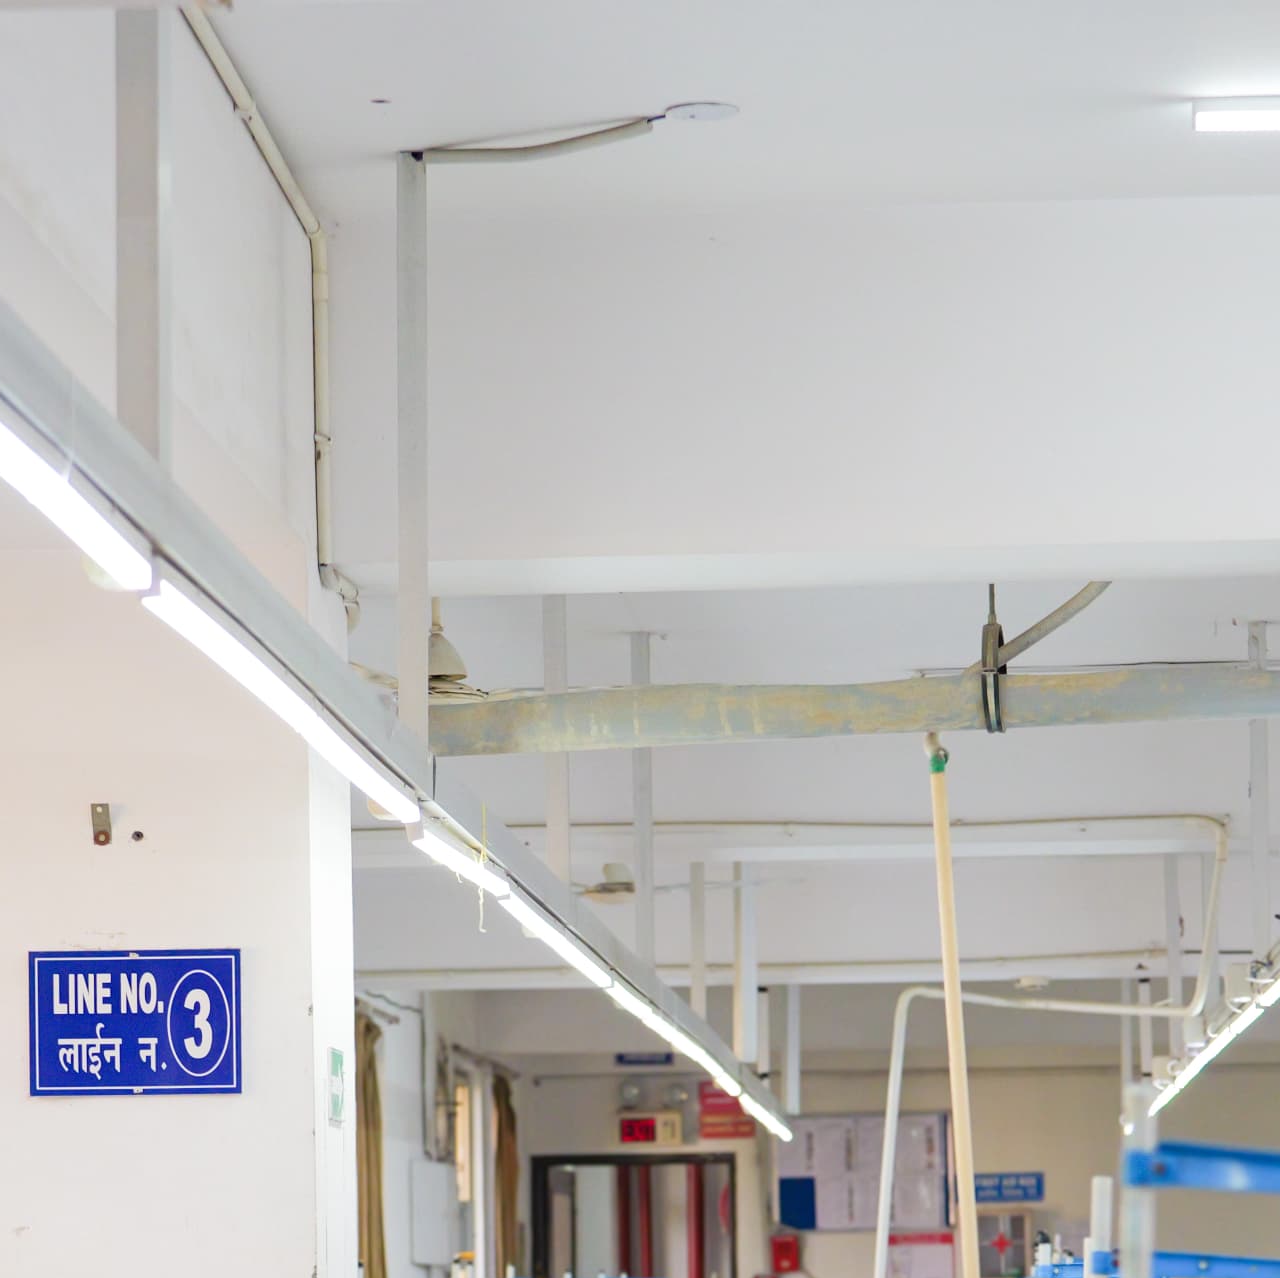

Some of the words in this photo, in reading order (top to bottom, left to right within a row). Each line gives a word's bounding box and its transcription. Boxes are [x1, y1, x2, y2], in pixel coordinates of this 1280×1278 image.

[53, 973, 112, 1014] LINE
[120, 972, 164, 1014] NO.
[57, 1022, 122, 1080] लाईन
[183, 988, 213, 1059] 3
